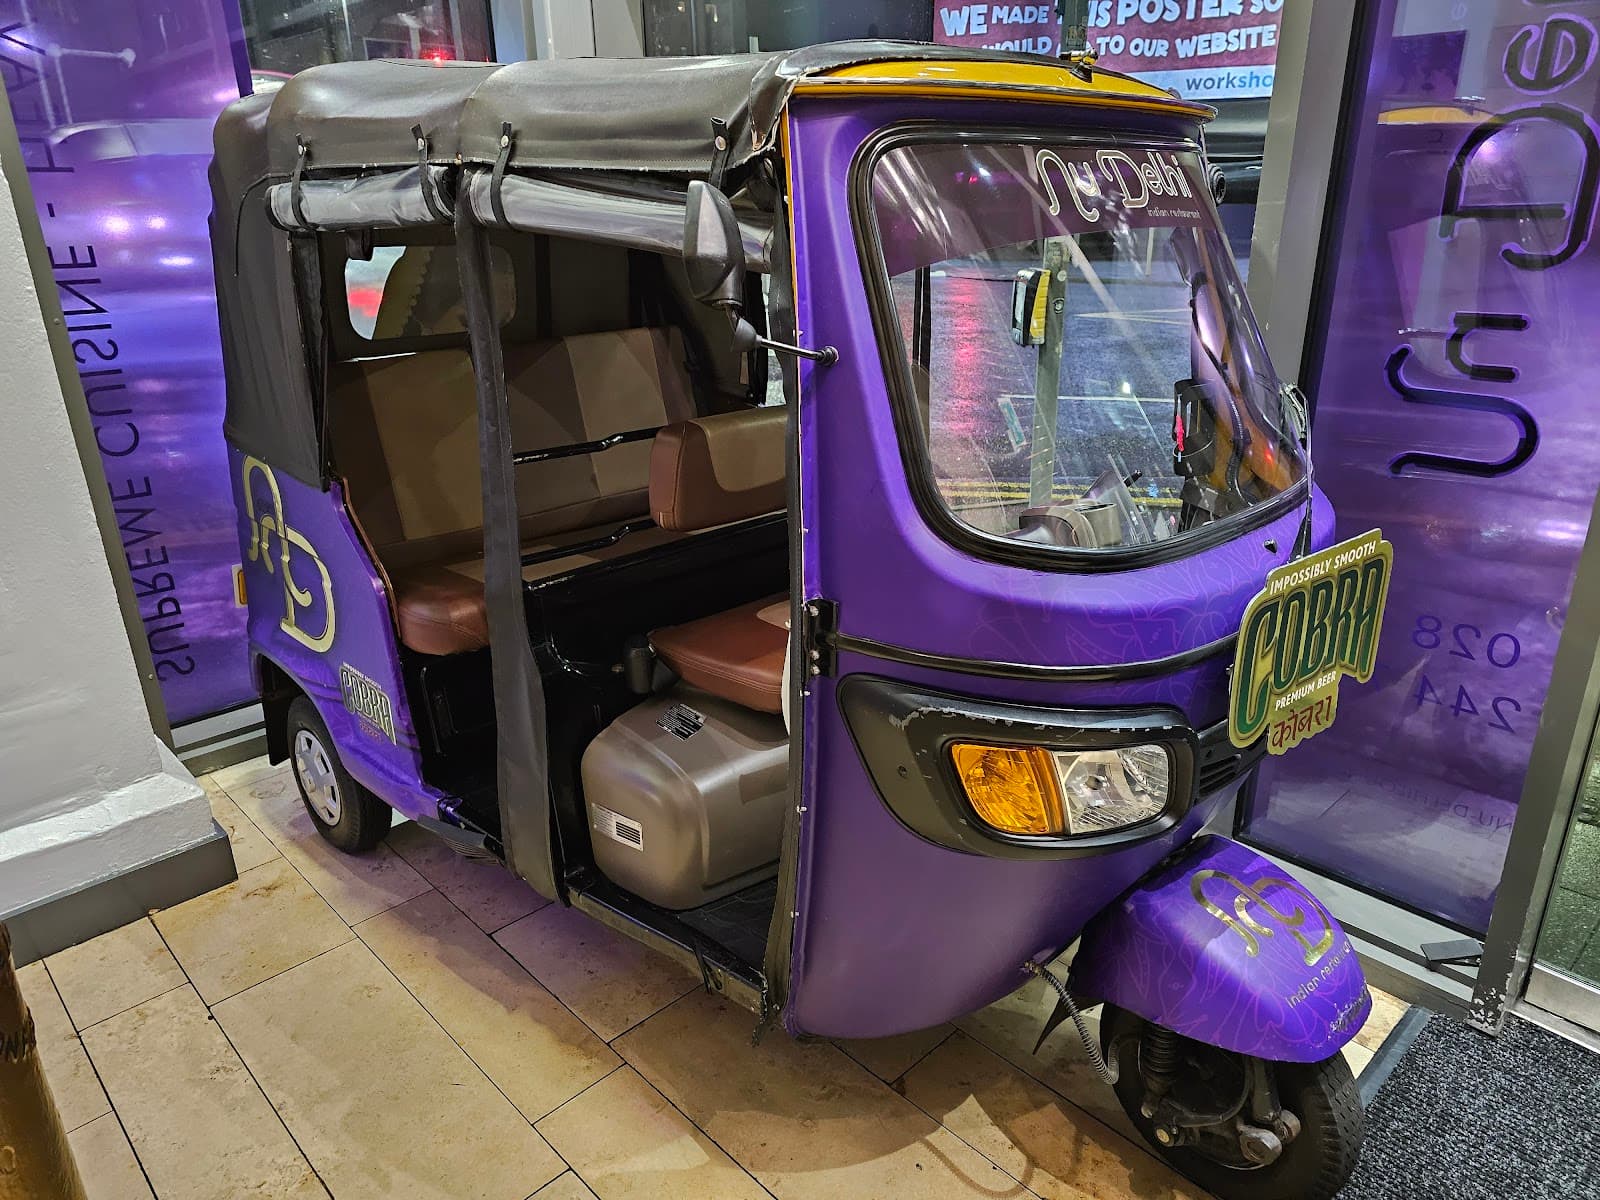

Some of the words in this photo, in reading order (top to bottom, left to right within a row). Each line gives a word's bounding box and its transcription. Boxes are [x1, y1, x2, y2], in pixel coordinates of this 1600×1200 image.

[940, 4, 988, 36] WE
[991, 6, 1049, 24] MADE
[1096, 34, 1125, 56] TO
[1129, 37, 1169, 57] OUR
[1175, 24, 1277, 59] WEBSITE
[1096, 149, 1193, 209] Delhi
[1269, 557, 1332, 596] IMPOSSIBLY
[1333, 540, 1377, 570] SMOOTH
[1230, 556, 1388, 738] COBRA
[339, 665, 398, 746] COBRA
[1275, 681, 1316, 711] PREMIUM
[1316, 670, 1337, 689] BEER
[1271, 695, 1333, 748] कोबरा
